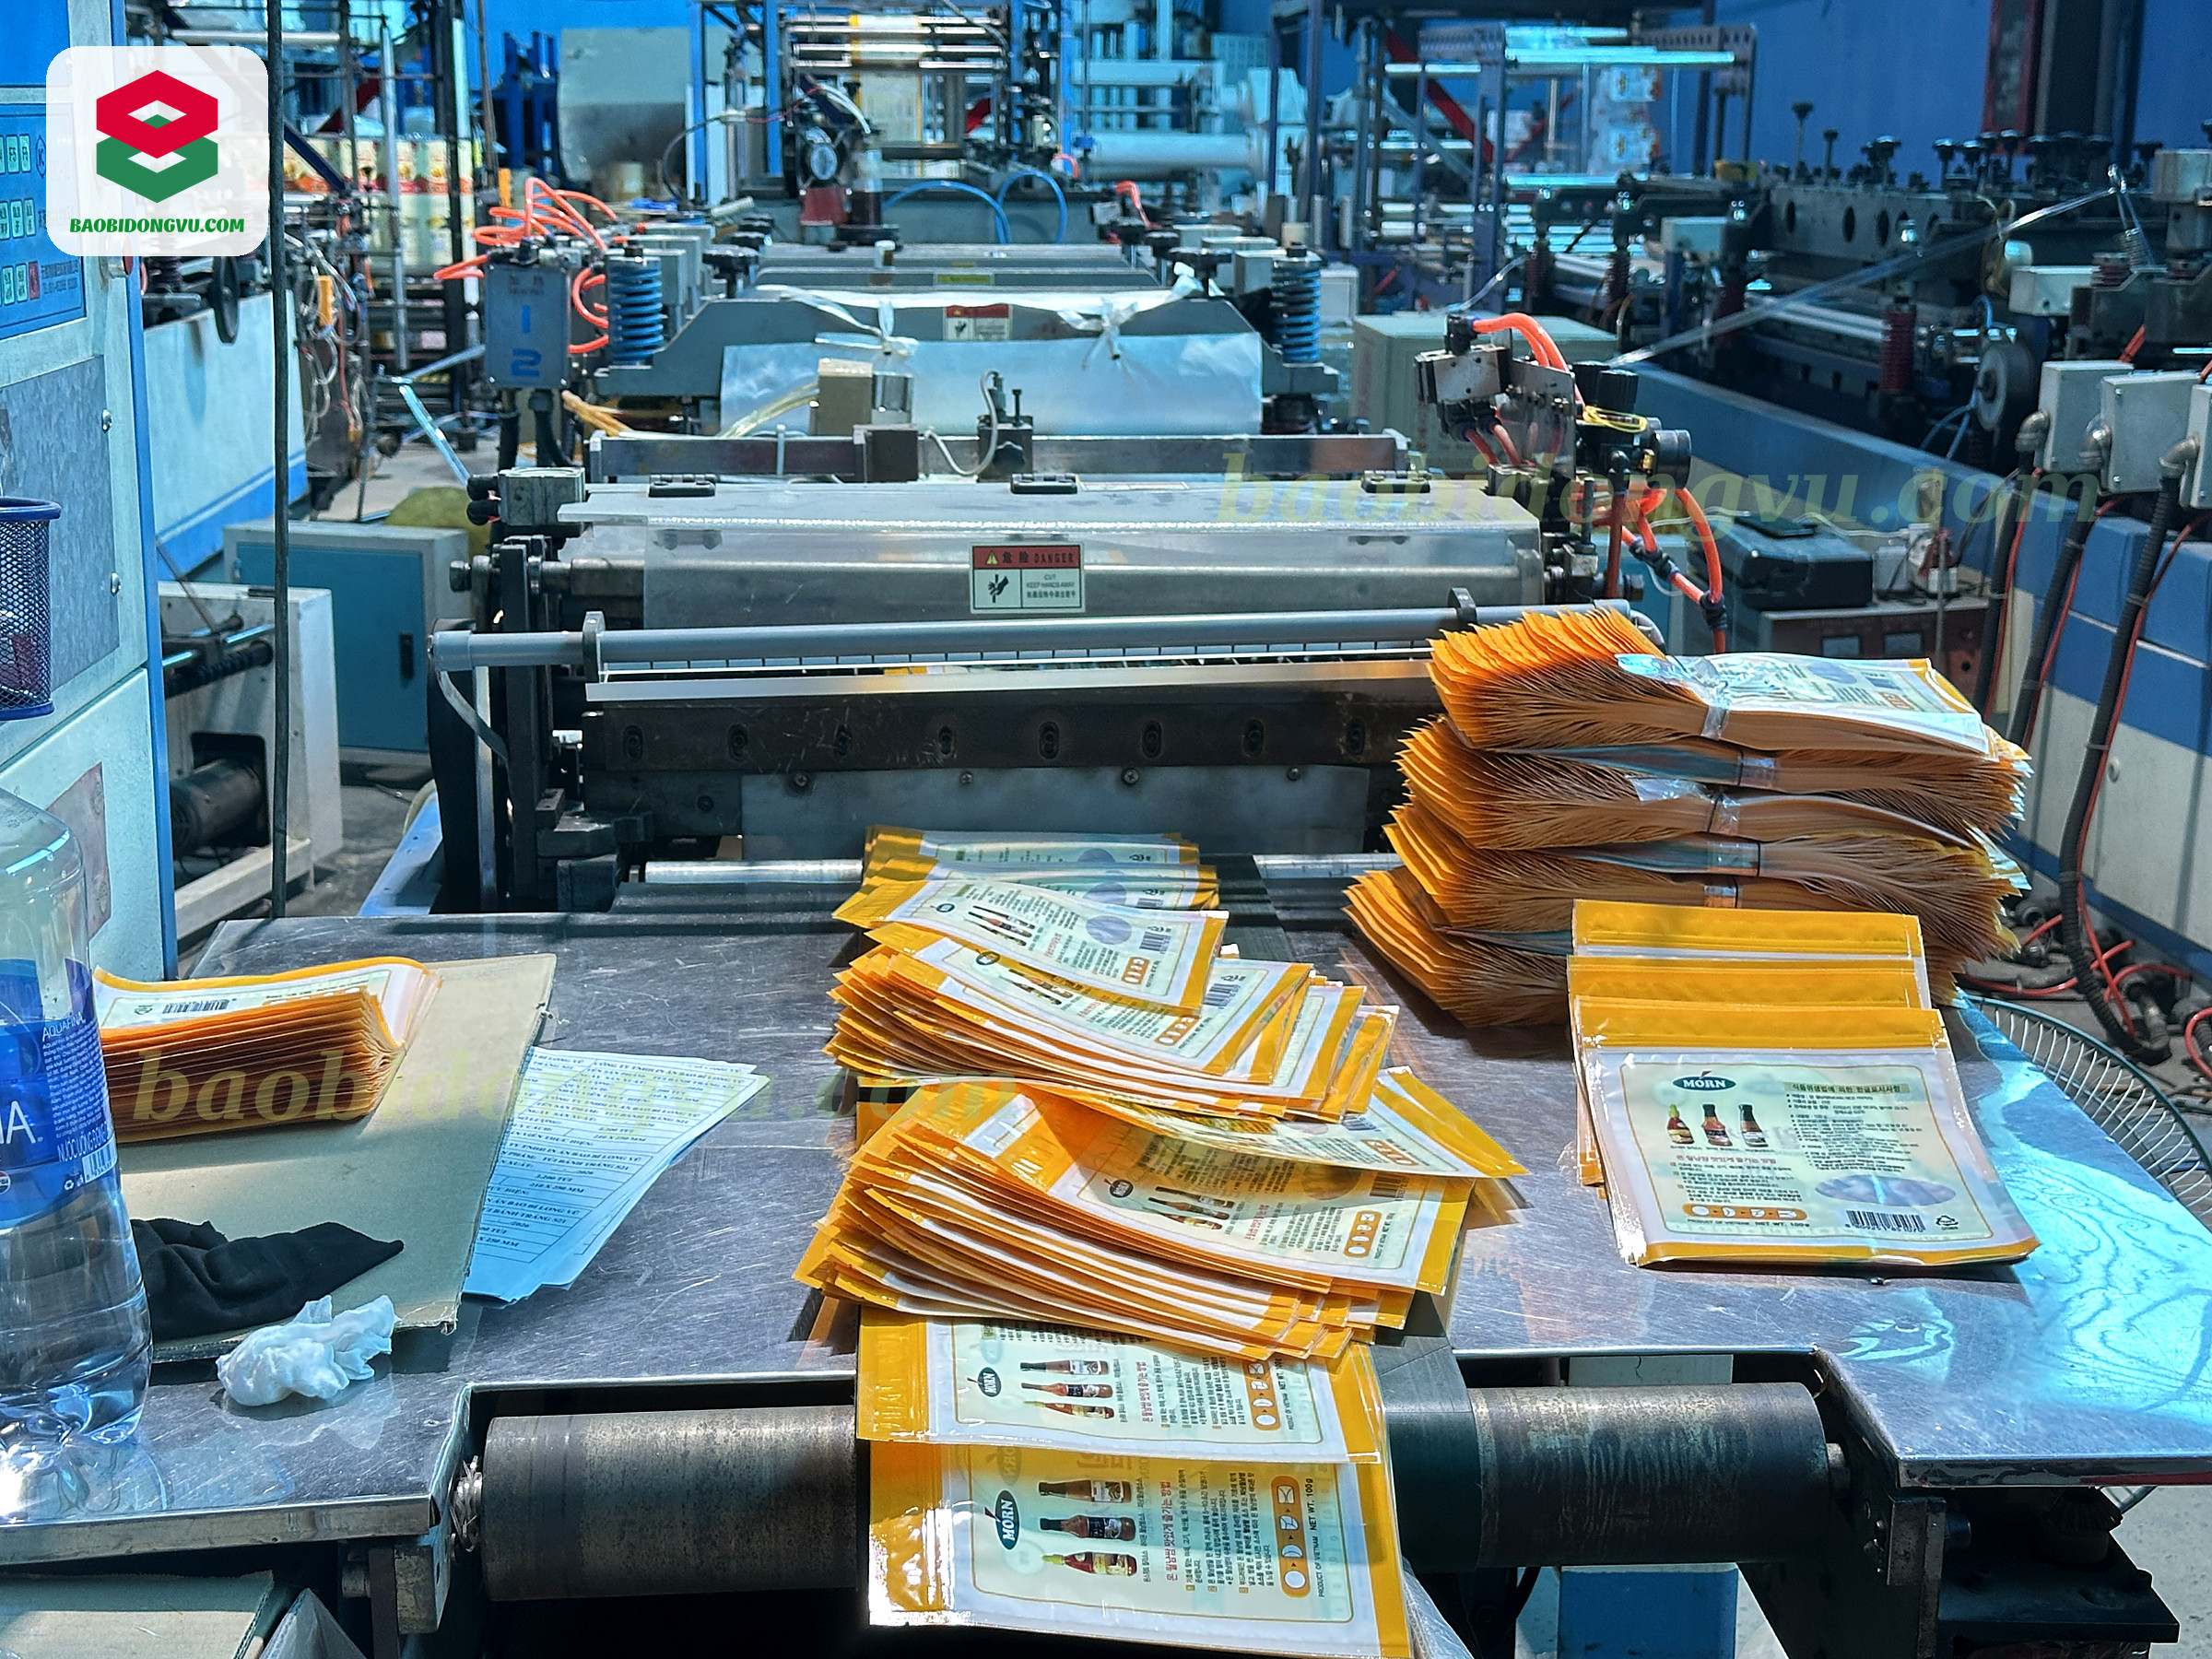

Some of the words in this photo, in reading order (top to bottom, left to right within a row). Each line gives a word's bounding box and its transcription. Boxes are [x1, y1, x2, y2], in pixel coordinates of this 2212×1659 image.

[512, 348, 541, 376] 2
[1034, 553, 1074, 563] DANGER
[1683, 1079, 1726, 1088] MORN
[983, 1372, 997, 1394] MORN
[1277, 1381, 1286, 1390] NET
[1159, 1481, 1171, 1497] 방법
[1305, 1478, 1313, 1497] 100g
[1001, 1499, 1016, 1540] MORN
[1160, 1499, 1172, 1522] 즐기는
[1309, 1516, 1317, 1530] NET
[1162, 1524, 1174, 1547] 맛있게
[1312, 1535, 1321, 1560] VIETNAM
[1165, 1548, 1177, 1571] 월남쌈
[1316, 1571, 1325, 1597] PRODUCT
